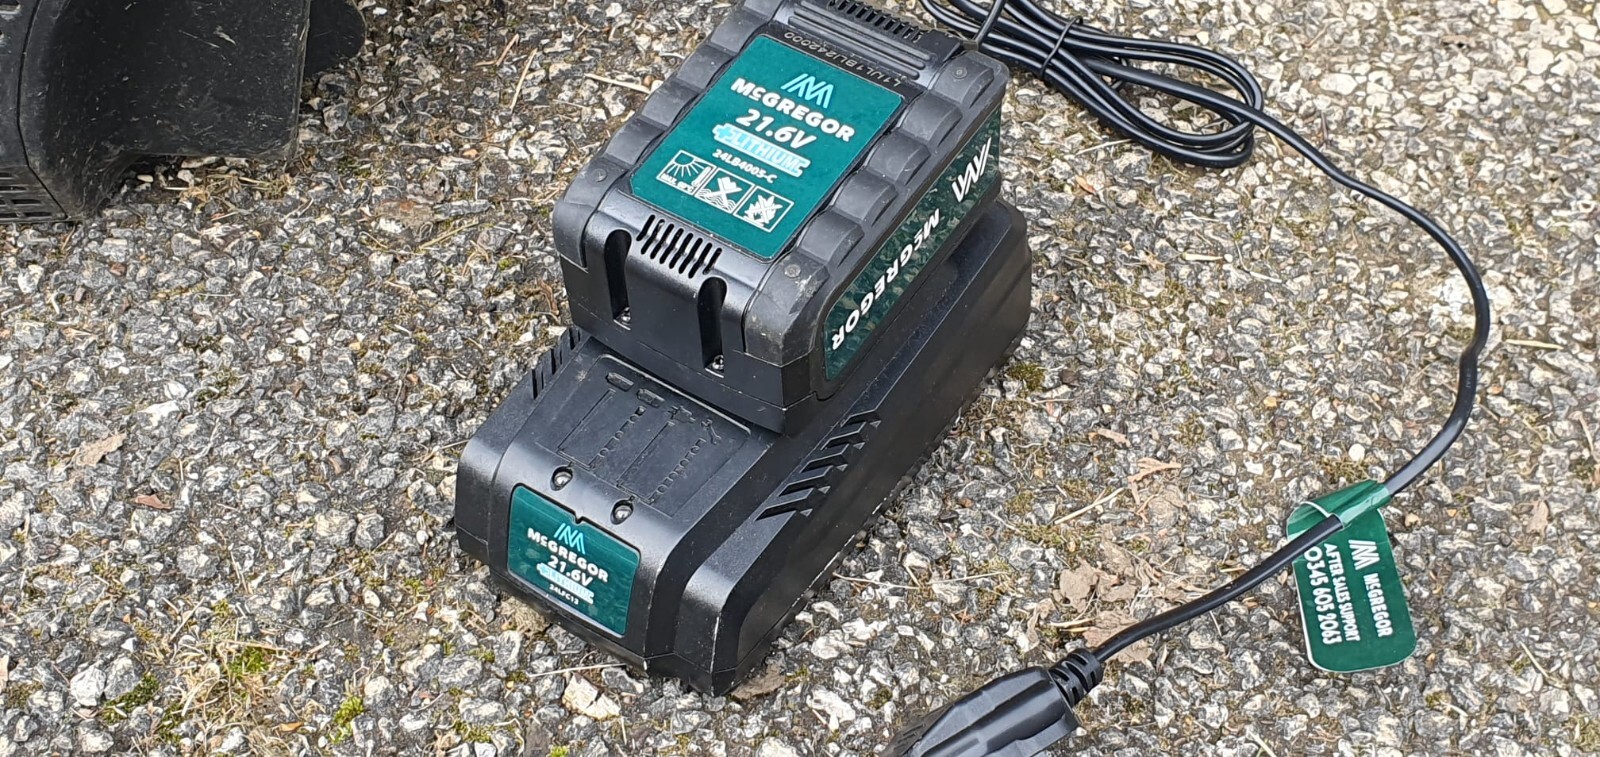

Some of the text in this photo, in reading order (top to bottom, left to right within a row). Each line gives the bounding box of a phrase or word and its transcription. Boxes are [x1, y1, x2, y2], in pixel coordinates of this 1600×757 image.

[730, 77, 855, 142] McGREGOR
[735, 108, 817, 149] 21.6V
[831, 208, 940, 351] McGREGOR
[527, 527, 609, 583] McGREGOR
[547, 555, 593, 587] 21.6V
[1303, 546, 1343, 645] 0345 605 2063
[1323, 543, 1361, 642] AFTER SALES SUPPORT
[1363, 572, 1394, 638] McGREGOR
